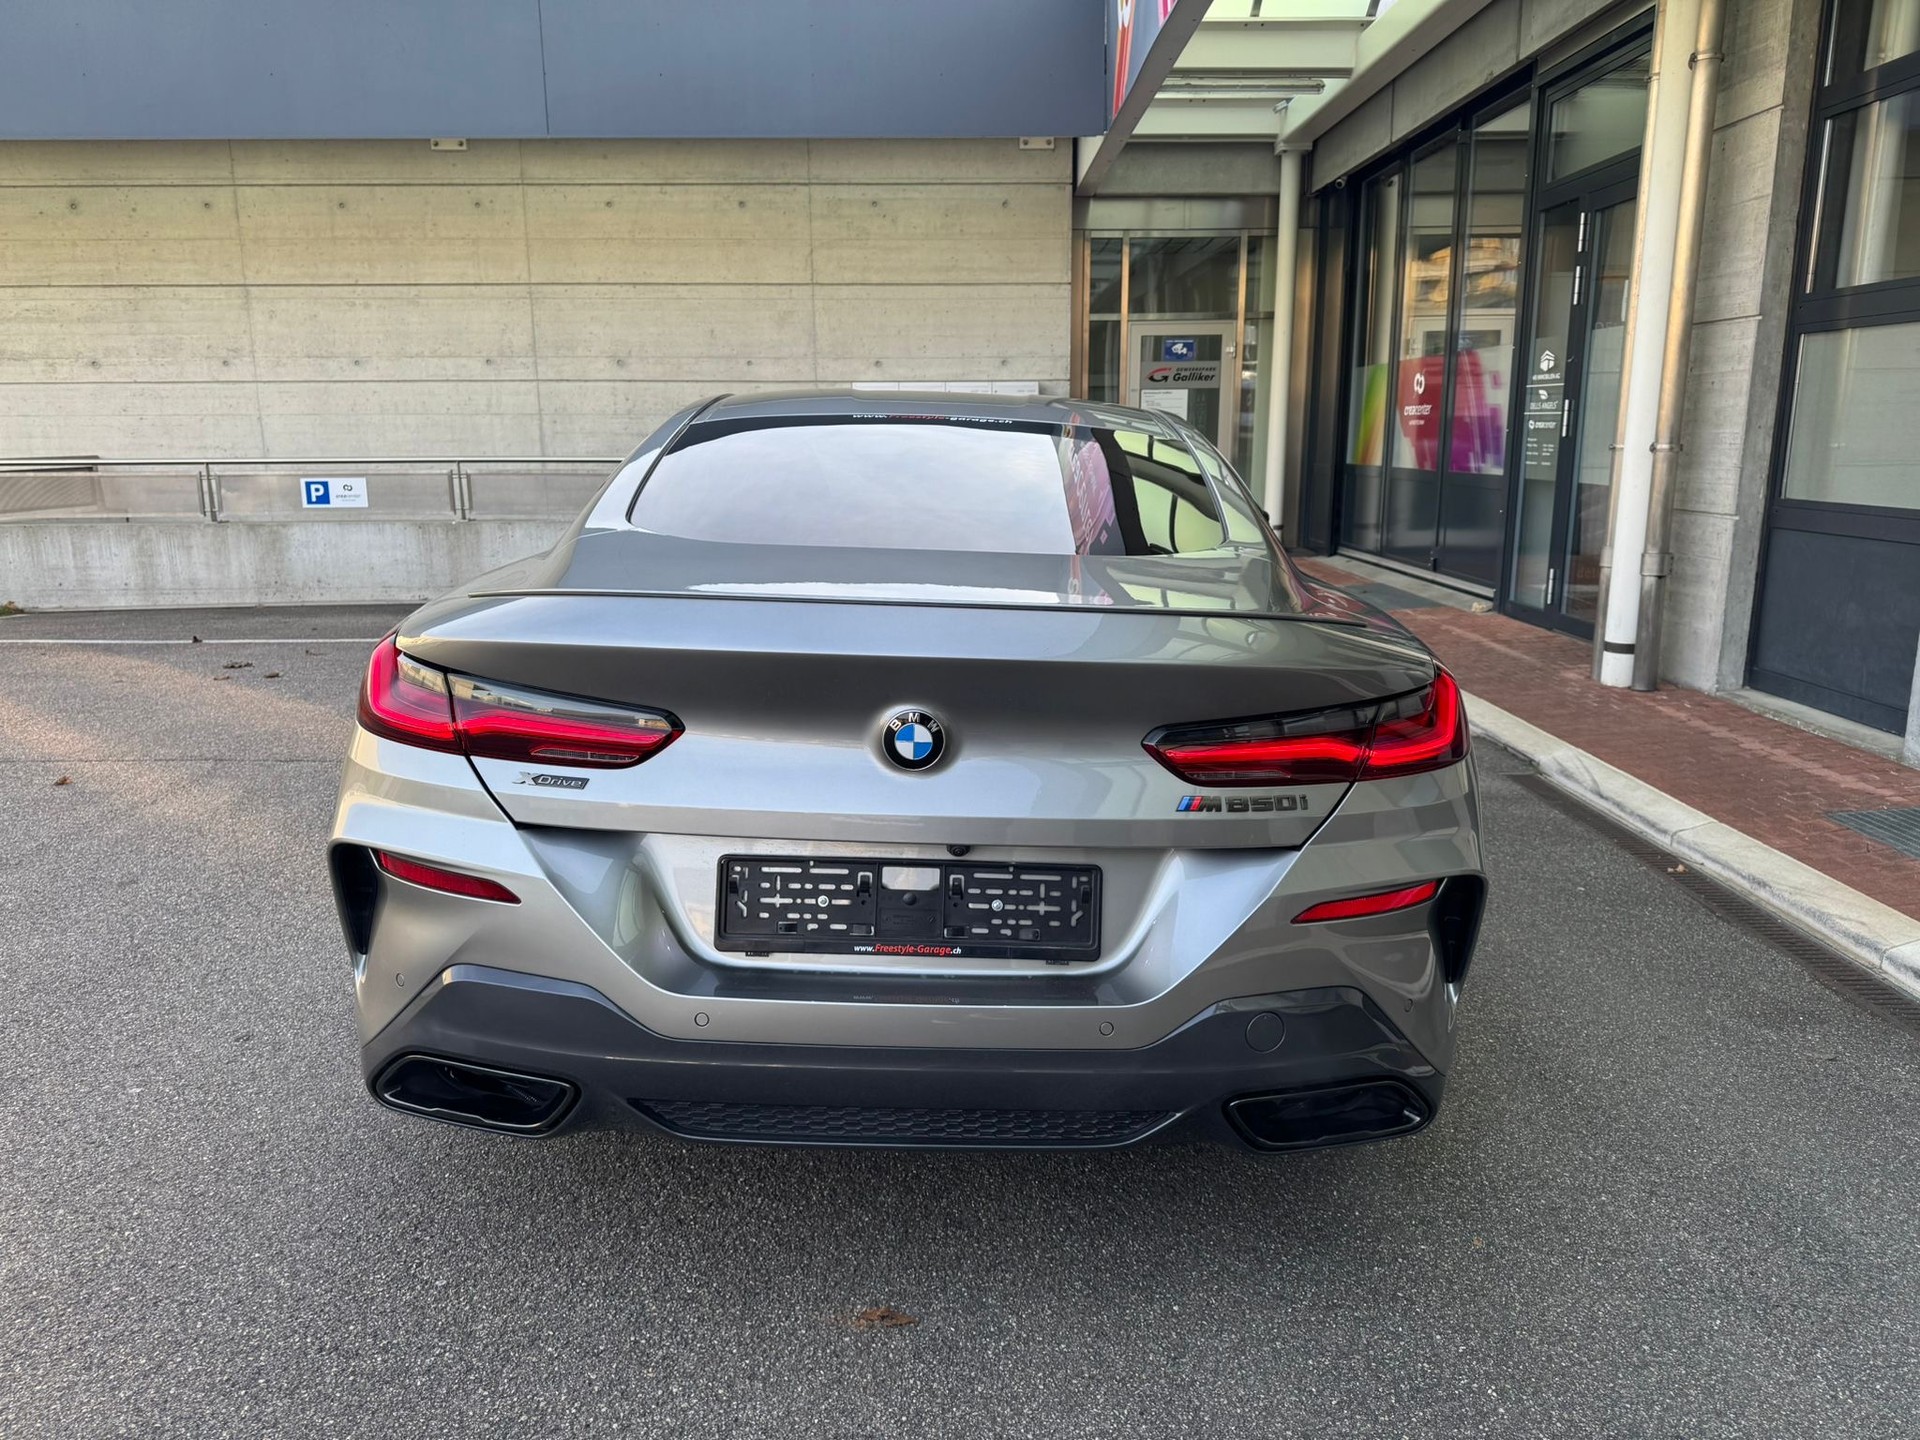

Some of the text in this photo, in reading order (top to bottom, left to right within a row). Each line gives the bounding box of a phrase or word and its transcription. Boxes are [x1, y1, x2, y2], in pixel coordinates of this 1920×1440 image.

[1173, 372, 1216, 382] Galliker
[310, 483, 325, 503] P
[890, 712, 940, 733] BMW
[854, 943, 962, 956] www.Freestyle-Garage.ch
